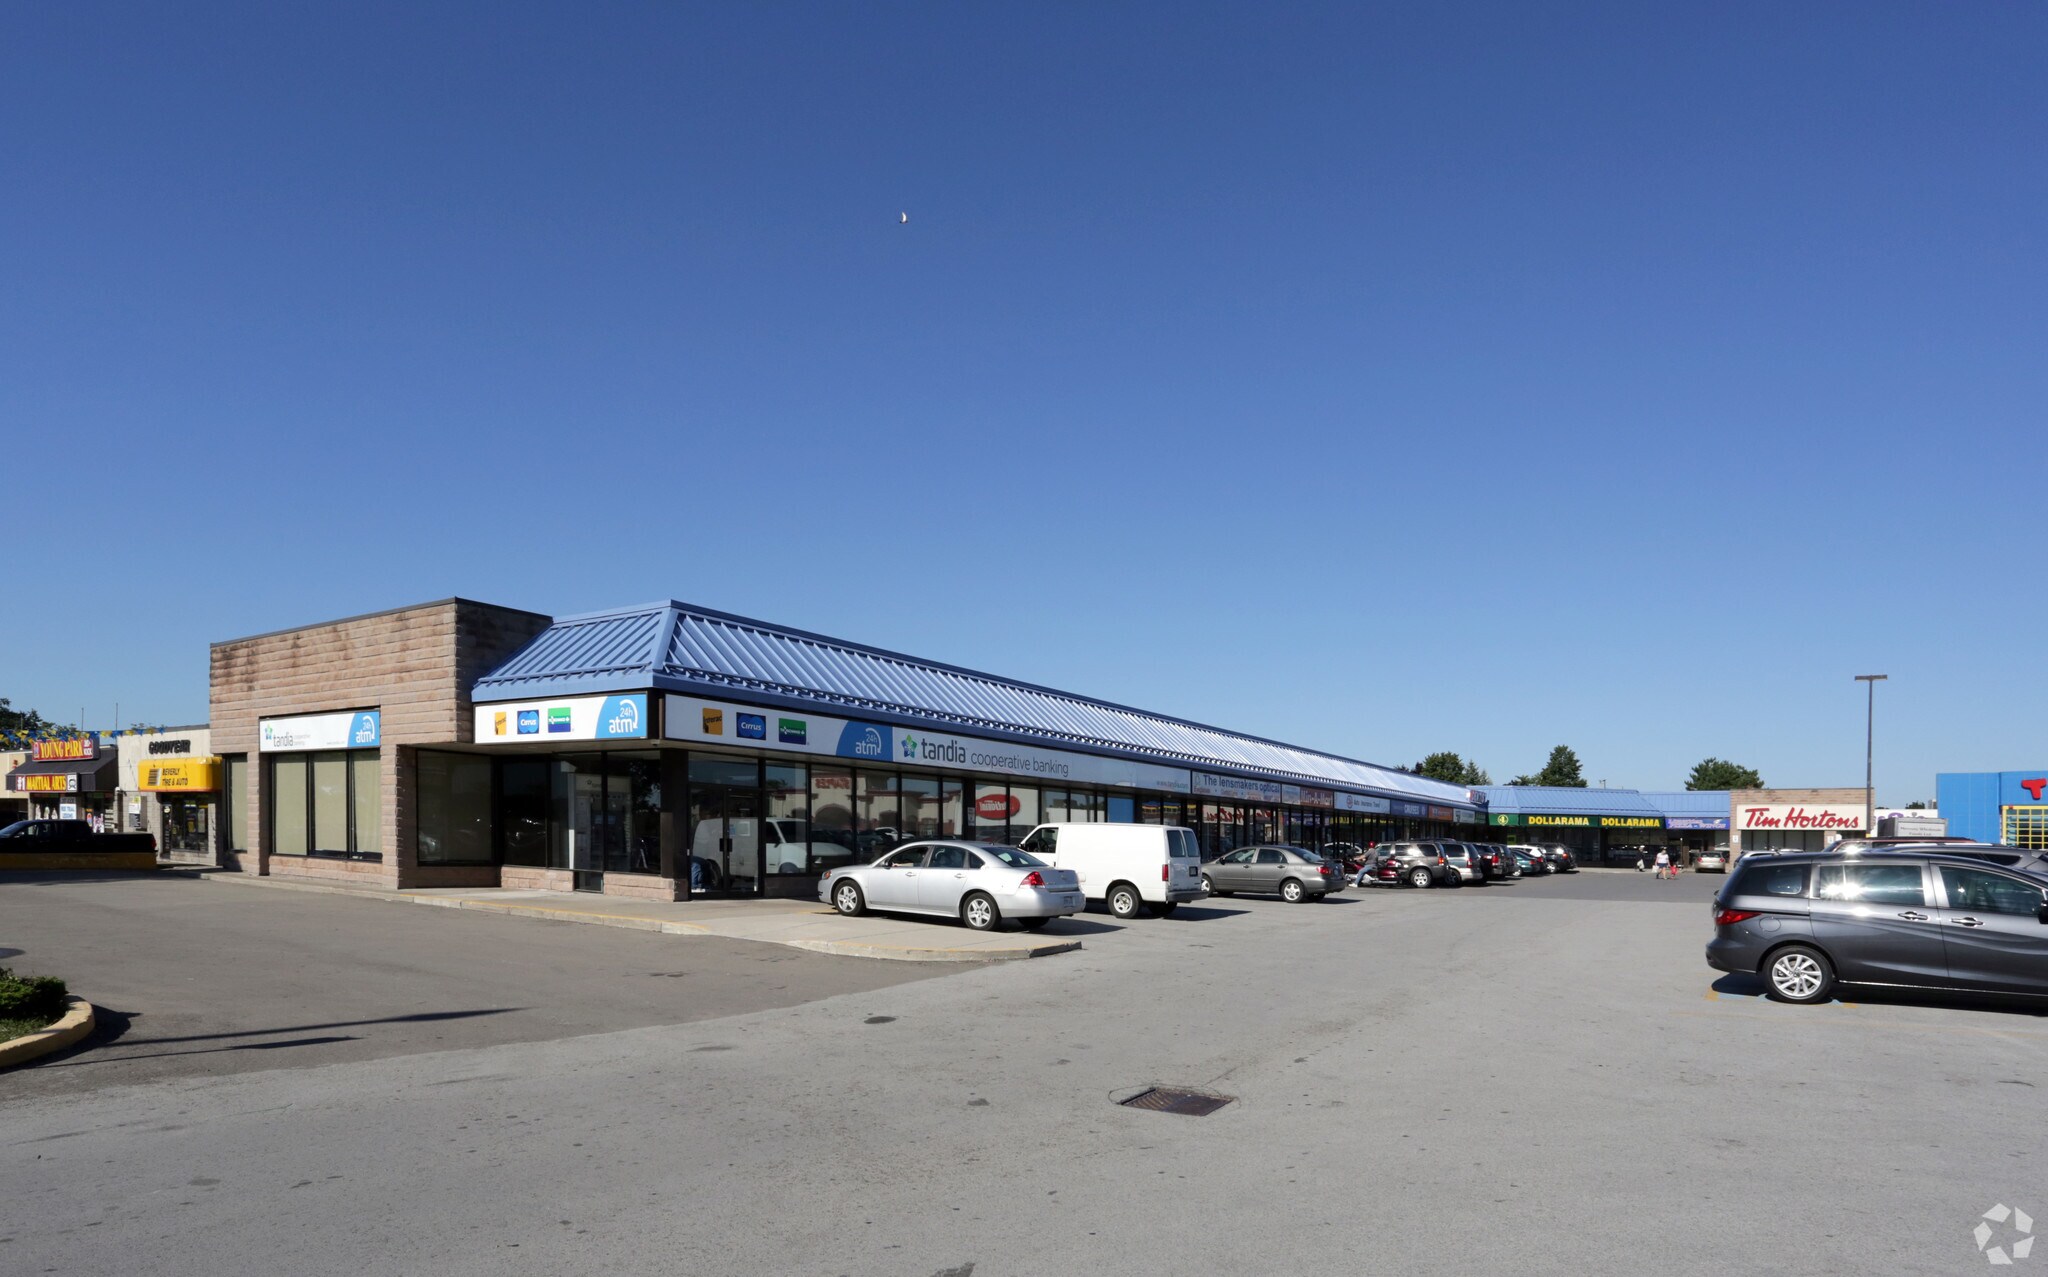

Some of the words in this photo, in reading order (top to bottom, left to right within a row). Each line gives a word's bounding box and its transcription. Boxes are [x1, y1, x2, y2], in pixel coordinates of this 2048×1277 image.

[619, 707, 634, 718] 24h
[520, 718, 537, 726] Cirrus
[608, 717, 634, 733] atm
[740, 721, 762, 731] Cirrus
[273, 731, 294, 747] tandia
[355, 730, 372, 743] atm
[865, 733, 878, 743] 24h
[40, 741, 64, 758] YOUNG
[64, 739, 84, 757] PARK
[148, 739, 191, 755] GOODYEAR
[855, 742, 878, 756] atm
[921, 738, 967, 763] tandia
[970, 752, 1031, 771] cooperative
[1032, 760, 1069, 778] banking
[162, 768, 180, 776] BEVERLY
[17, 776, 25, 790] #1
[26, 776, 52, 791] MARTIAL
[52, 775, 67, 790] ARTS
[162, 778, 172, 786] TIRE
[176, 777, 188, 786] AUTO
[1202, 774, 1217, 786] The
[1219, 775, 1258, 791] lensmakers
[1259, 782, 1280, 794] optical
[1528, 816, 1589, 826] DOLLARAMA
[1601, 817, 1660, 827] DOLLARAMA
[1745, 807, 1780, 828] Tim
[1784, 806, 1859, 829] Hortons
